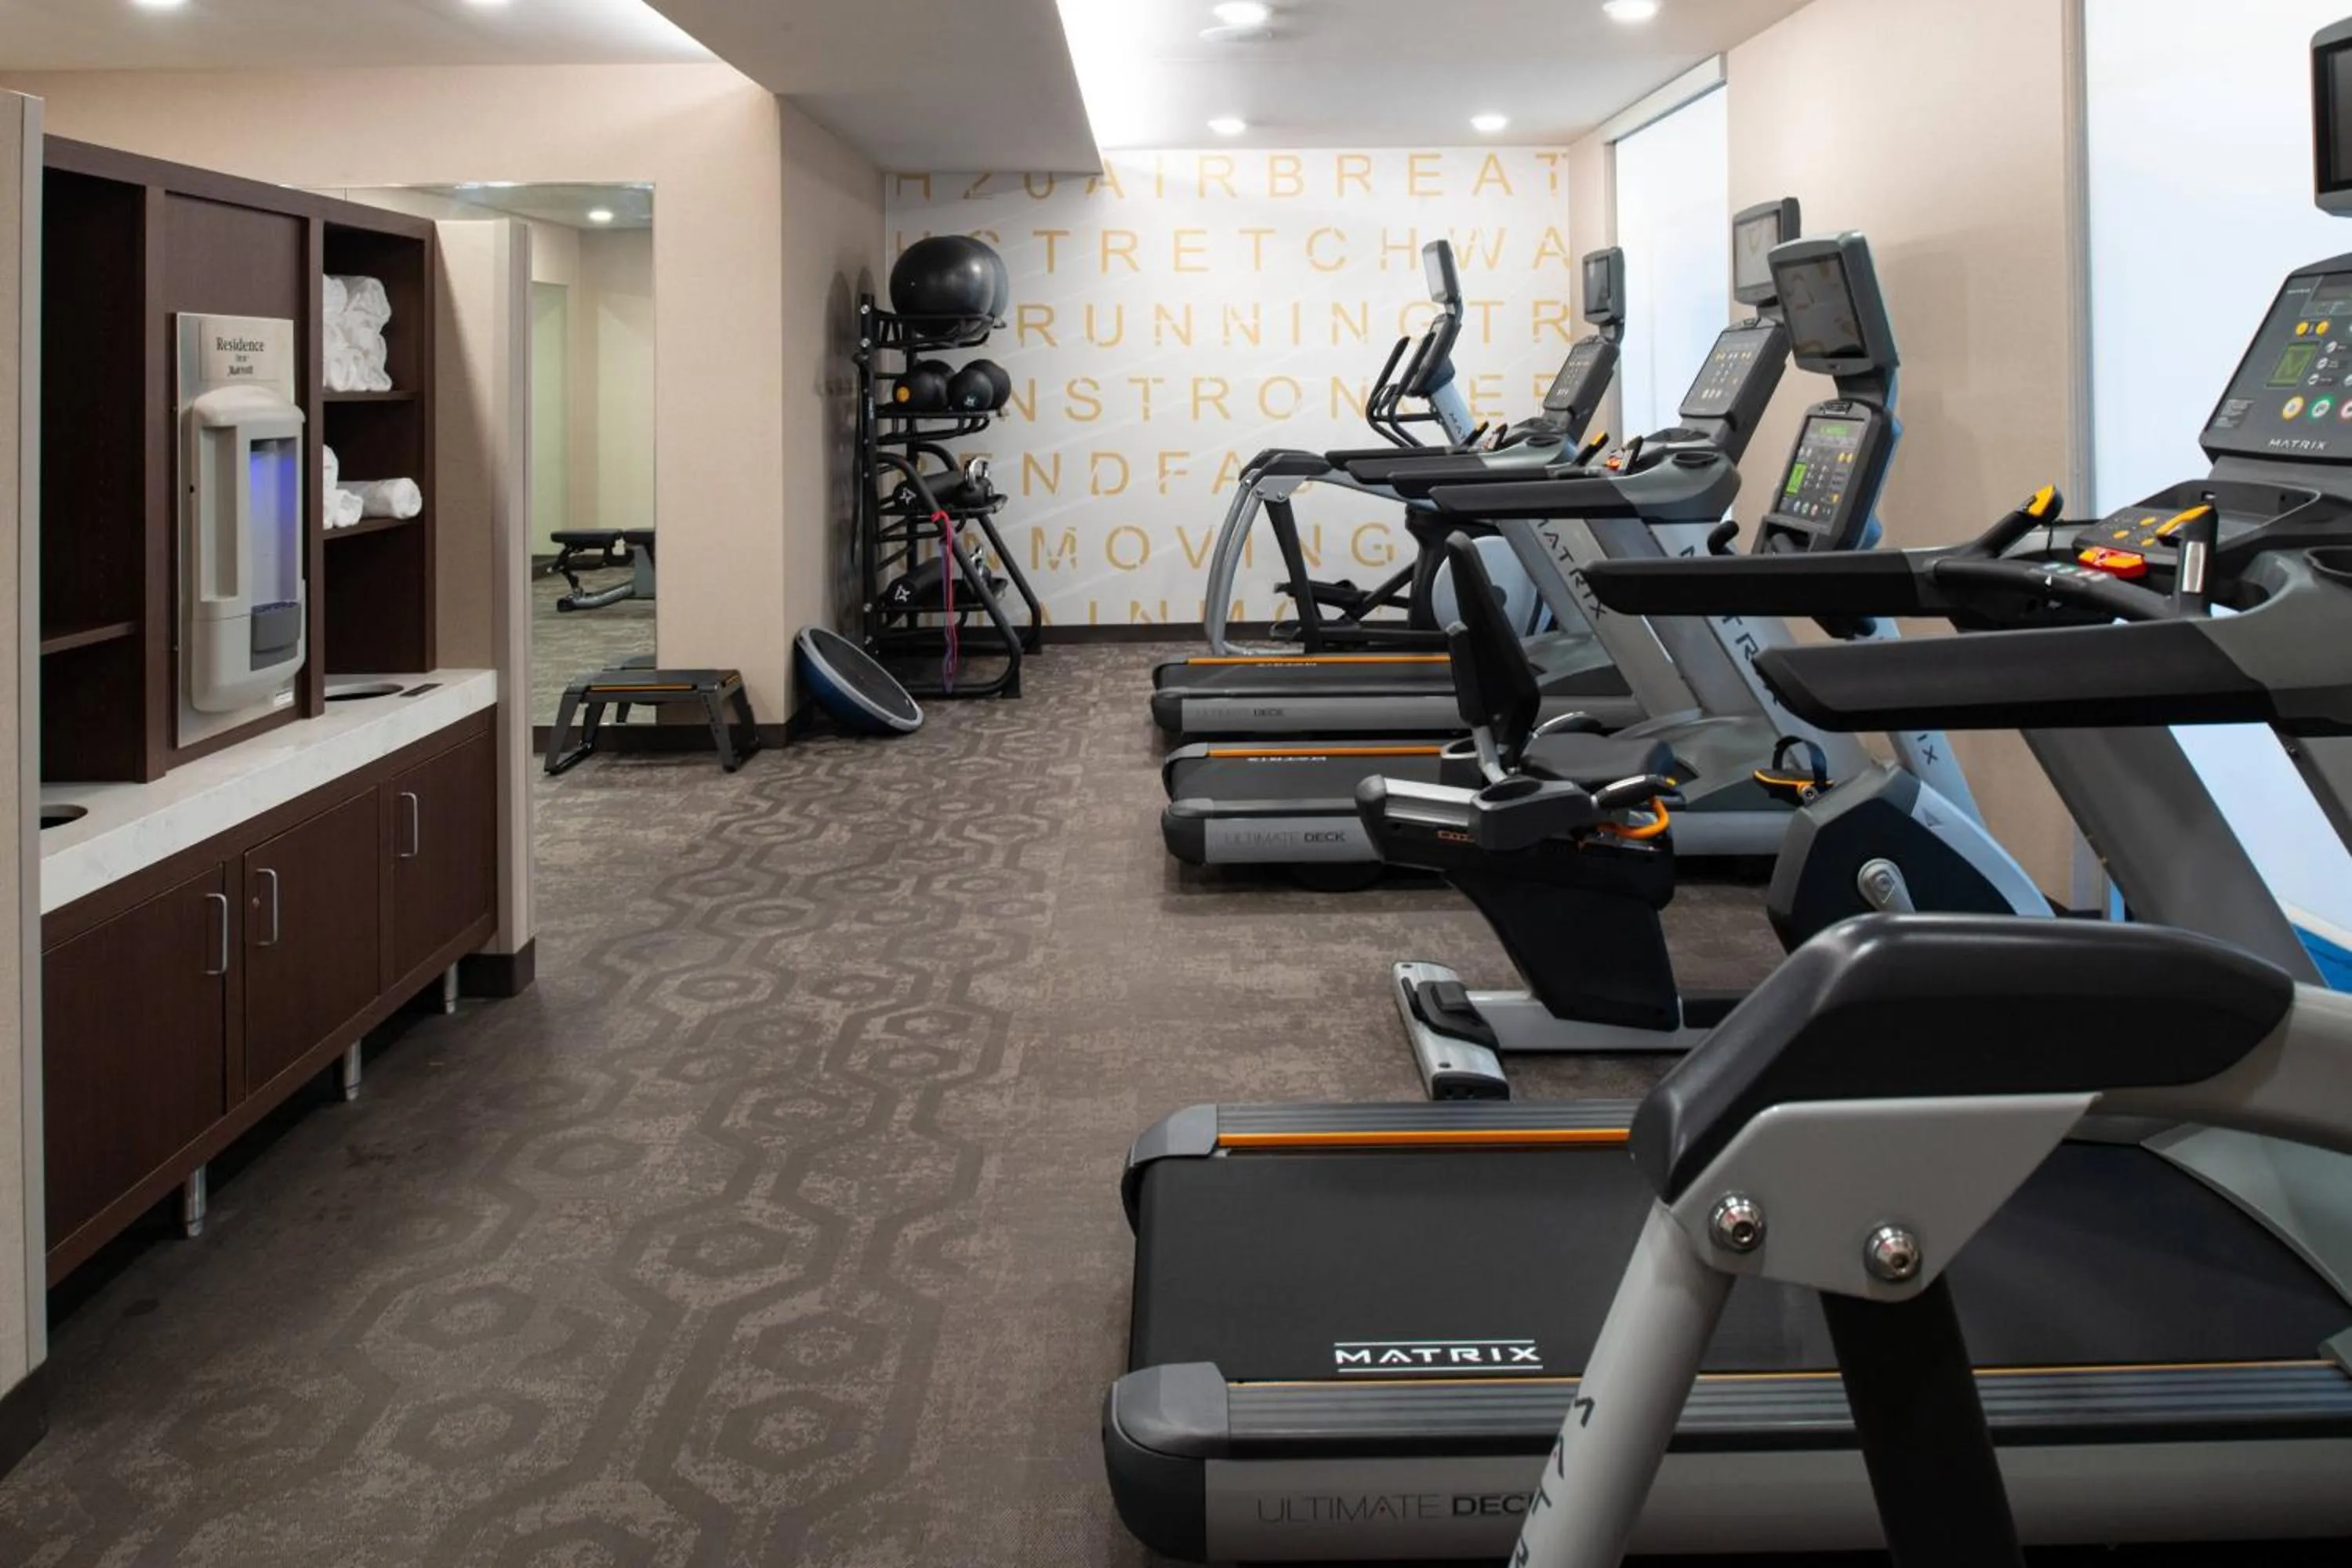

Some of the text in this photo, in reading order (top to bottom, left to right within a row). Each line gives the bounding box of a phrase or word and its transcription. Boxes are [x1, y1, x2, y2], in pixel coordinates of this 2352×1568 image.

[216, 337, 264, 352] Residence
[2267, 438, 2327, 451] MATRIX
[1304, 830, 1346, 843] DECK
[1334, 1347, 1541, 1364] MATRIX
[1258, 1493, 1534, 1523] ULTIMATE DEC
